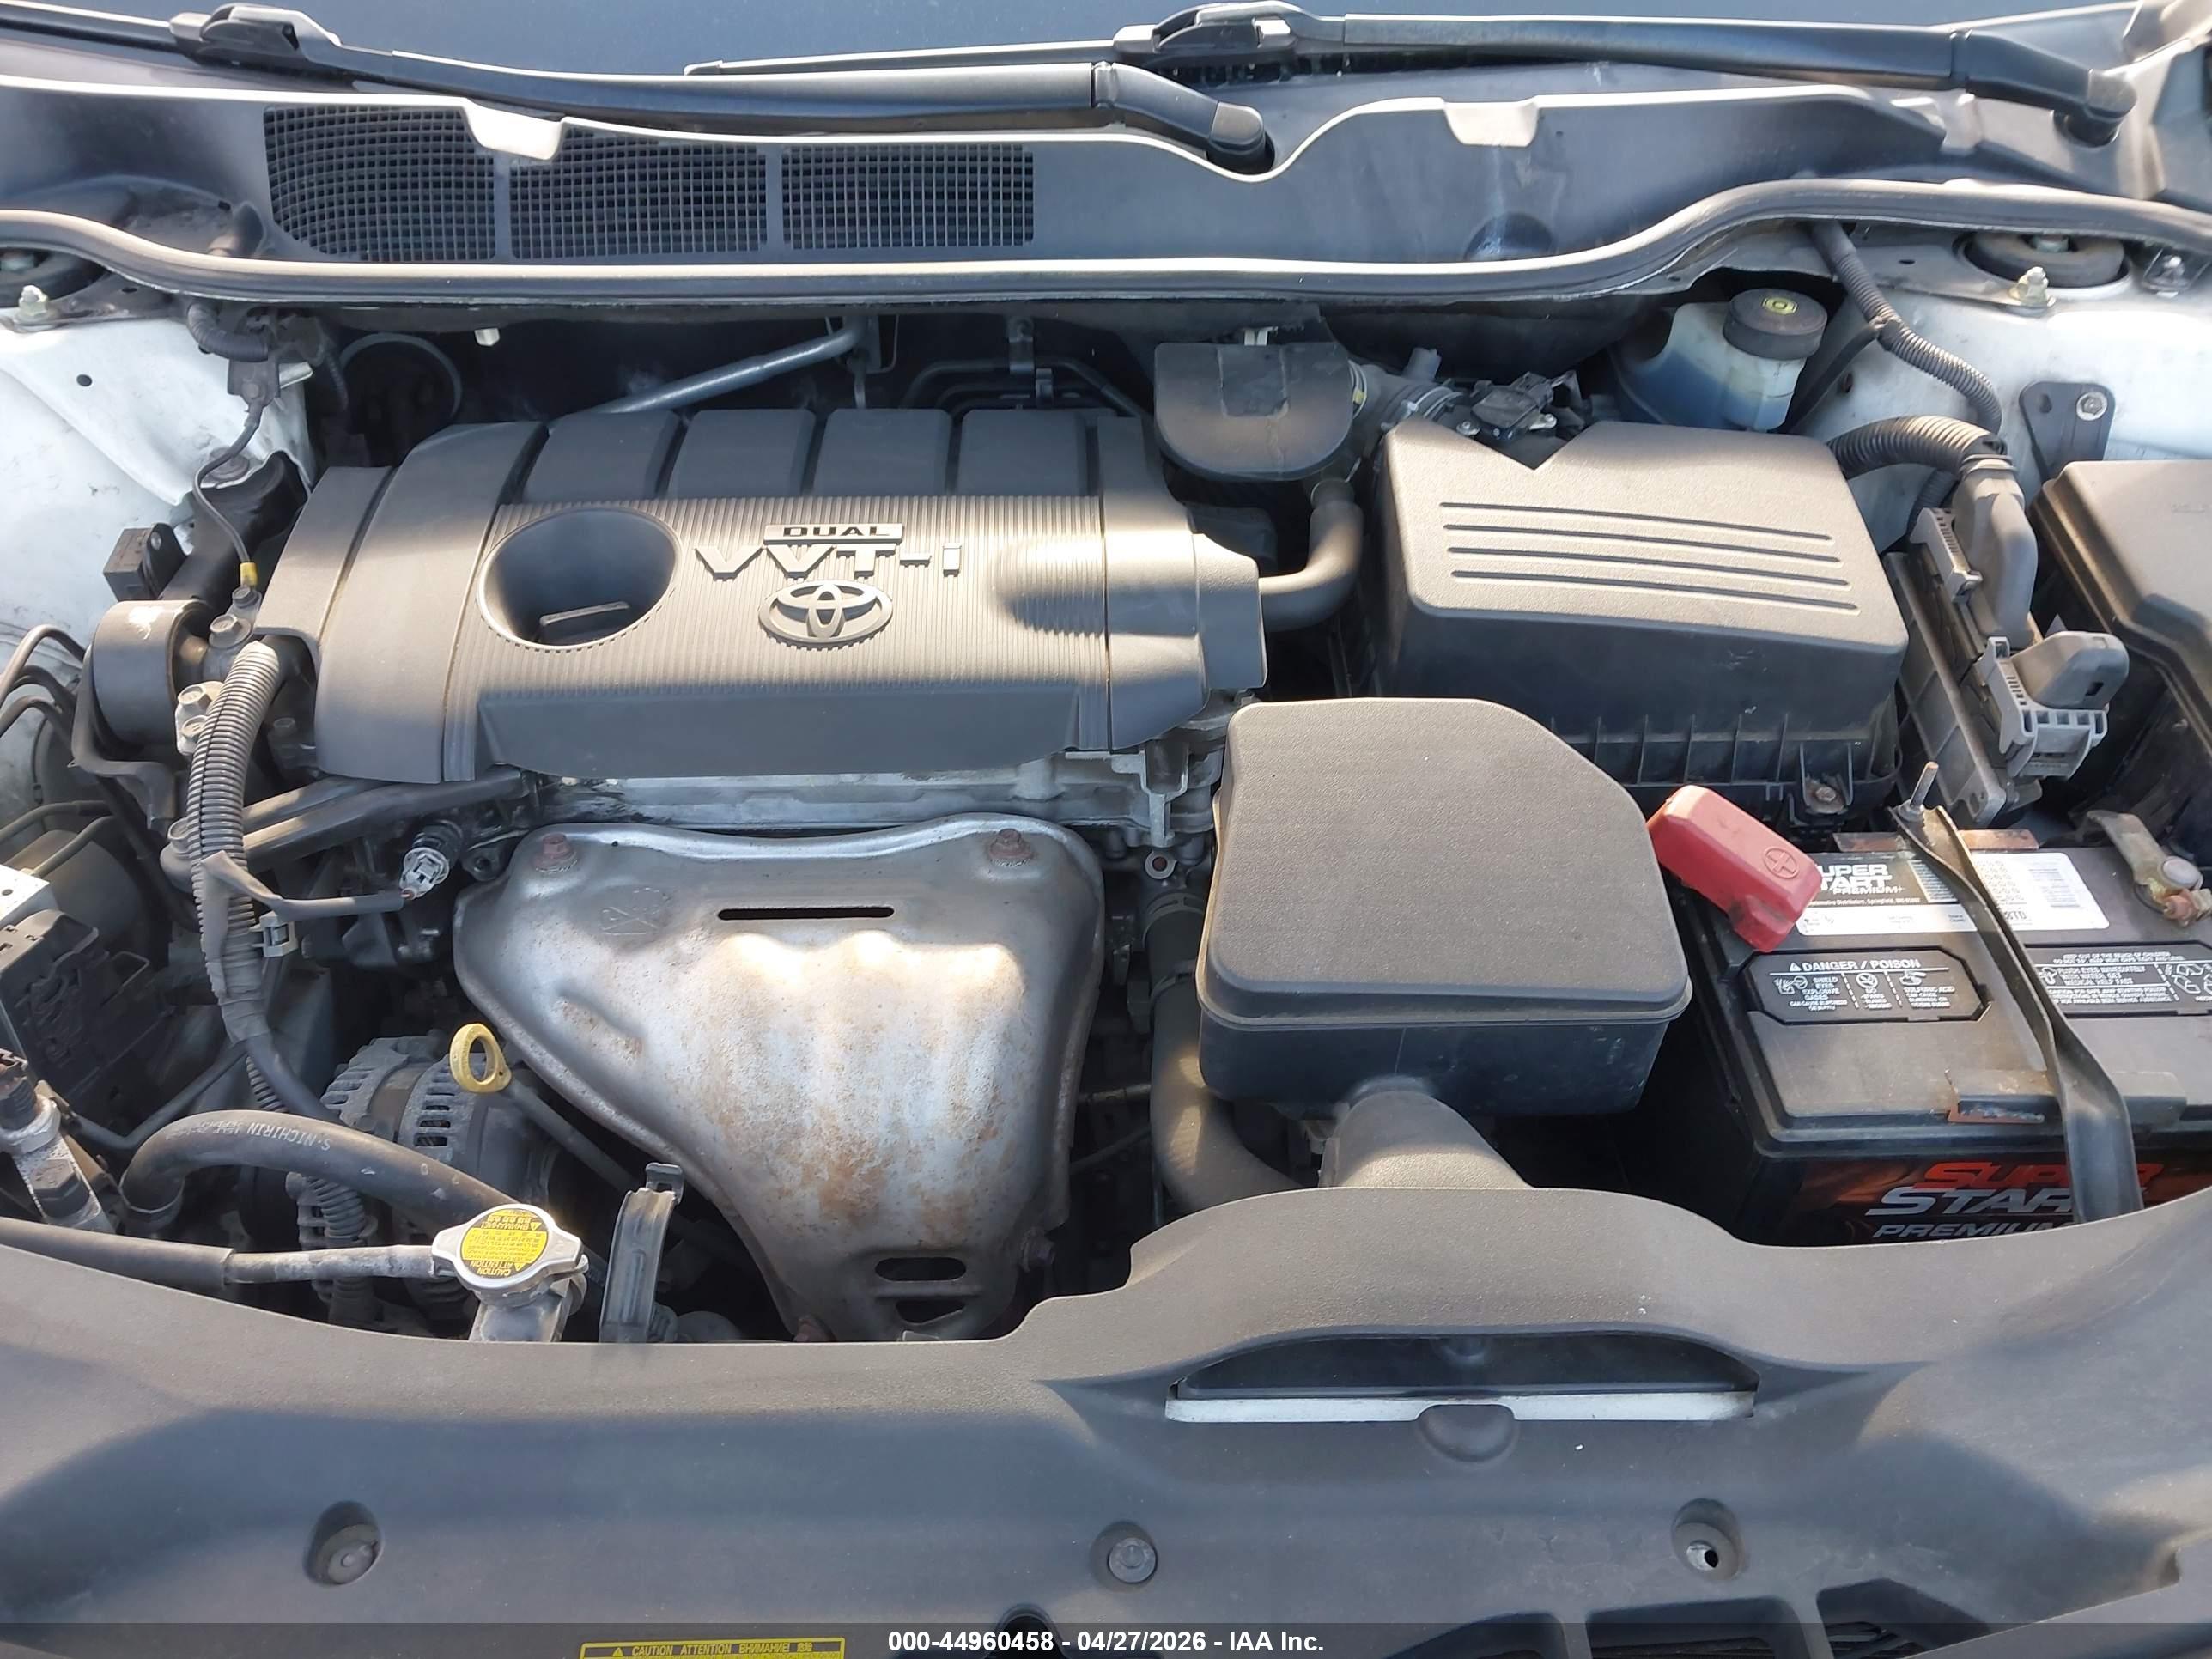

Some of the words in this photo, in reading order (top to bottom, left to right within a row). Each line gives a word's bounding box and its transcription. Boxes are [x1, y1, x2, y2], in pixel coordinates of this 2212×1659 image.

[783, 526, 890, 537] DUAL
[1815, 863, 1888, 877] UPER
[1820, 875, 1892, 890] TART
[1802, 961, 1858, 972] DANGER
[1860, 961, 1868, 969] /
[1870, 959, 1922, 969] POISON
[1864, 1186, 2148, 1216] STAR
[477, 1267, 511, 1276] CAUTION
[632, 1645, 673, 1656] CAUTION
[680, 1644, 731, 1654] ATTENTION
